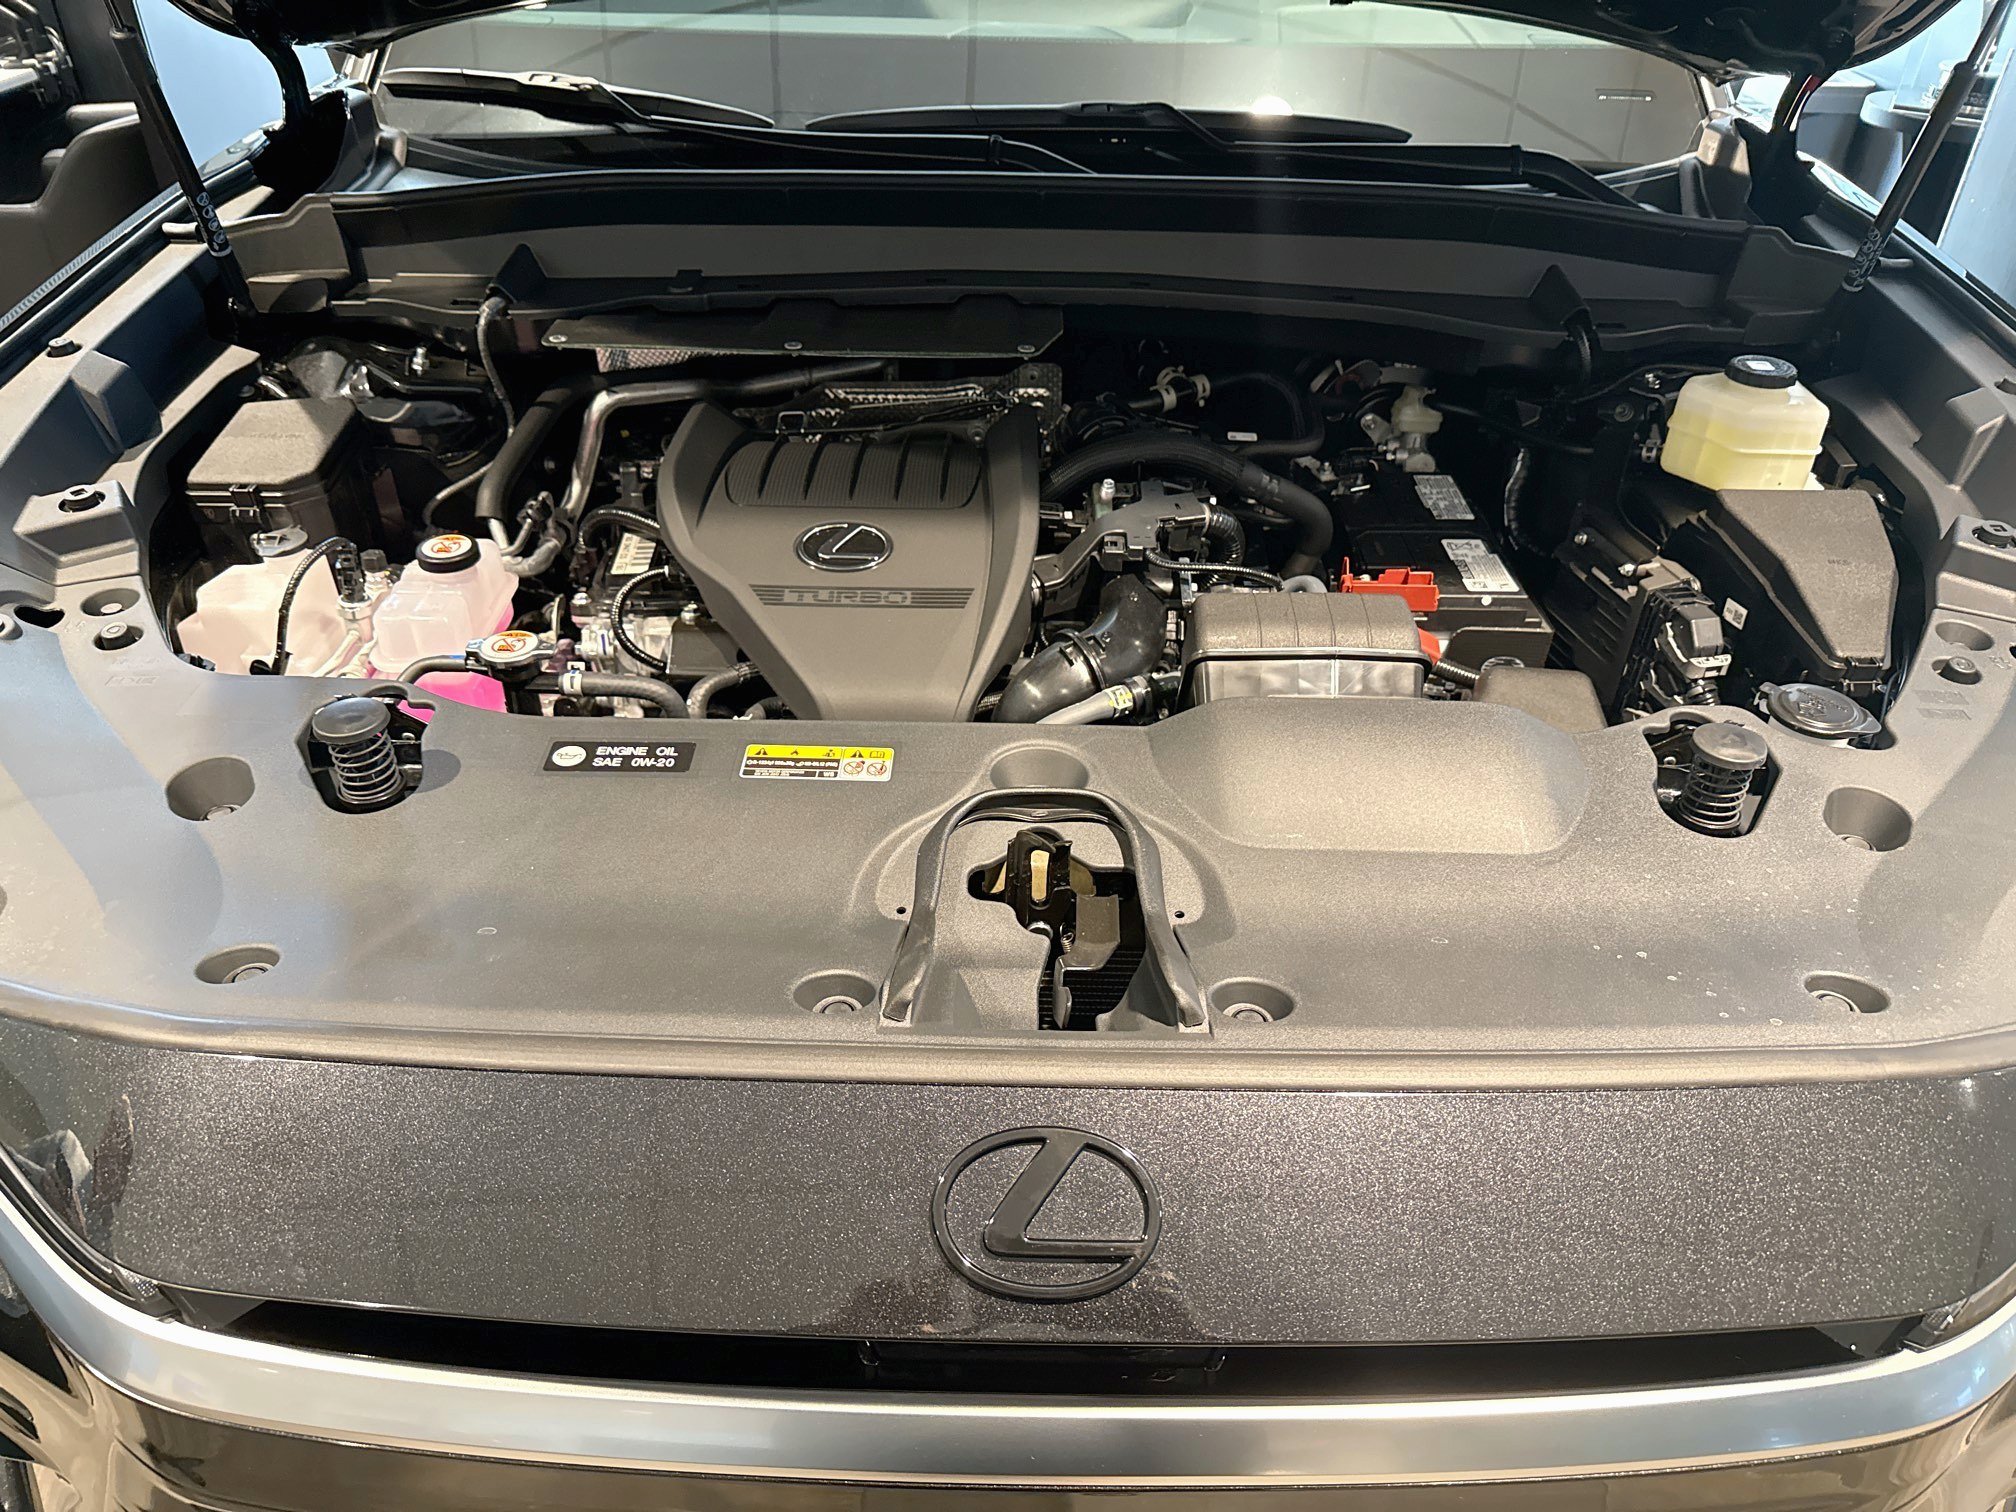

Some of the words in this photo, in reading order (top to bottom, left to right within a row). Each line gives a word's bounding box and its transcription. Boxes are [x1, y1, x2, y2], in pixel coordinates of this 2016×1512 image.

[788, 589, 909, 604] TURBO
[595, 746, 649, 756] ENGINE
[655, 746, 679, 757] OIL
[591, 757, 623, 767] SAE
[630, 758, 675, 768] 0W-20
